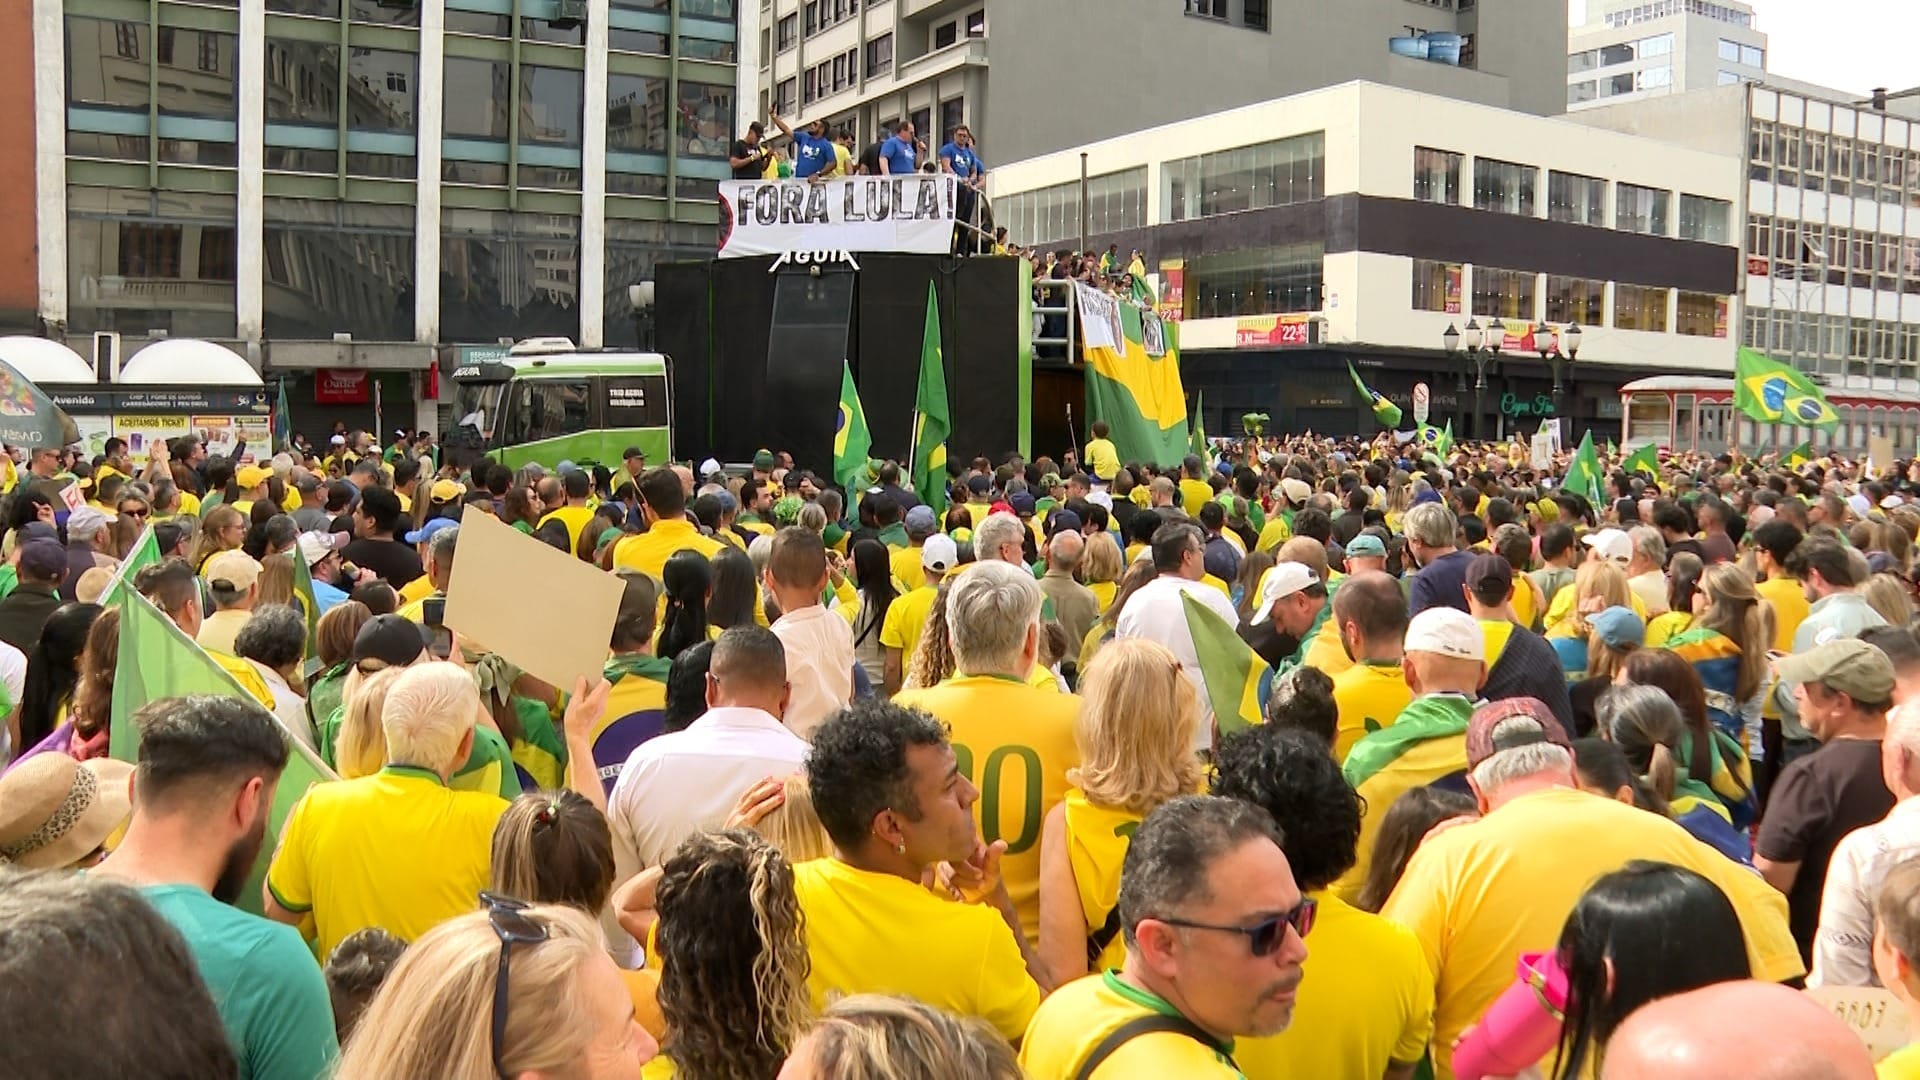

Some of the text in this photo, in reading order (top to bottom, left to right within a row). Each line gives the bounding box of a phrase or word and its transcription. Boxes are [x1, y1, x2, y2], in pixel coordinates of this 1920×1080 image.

[737, 177, 955, 226] FORA LULA!
[53, 394, 95, 405] Avenida
